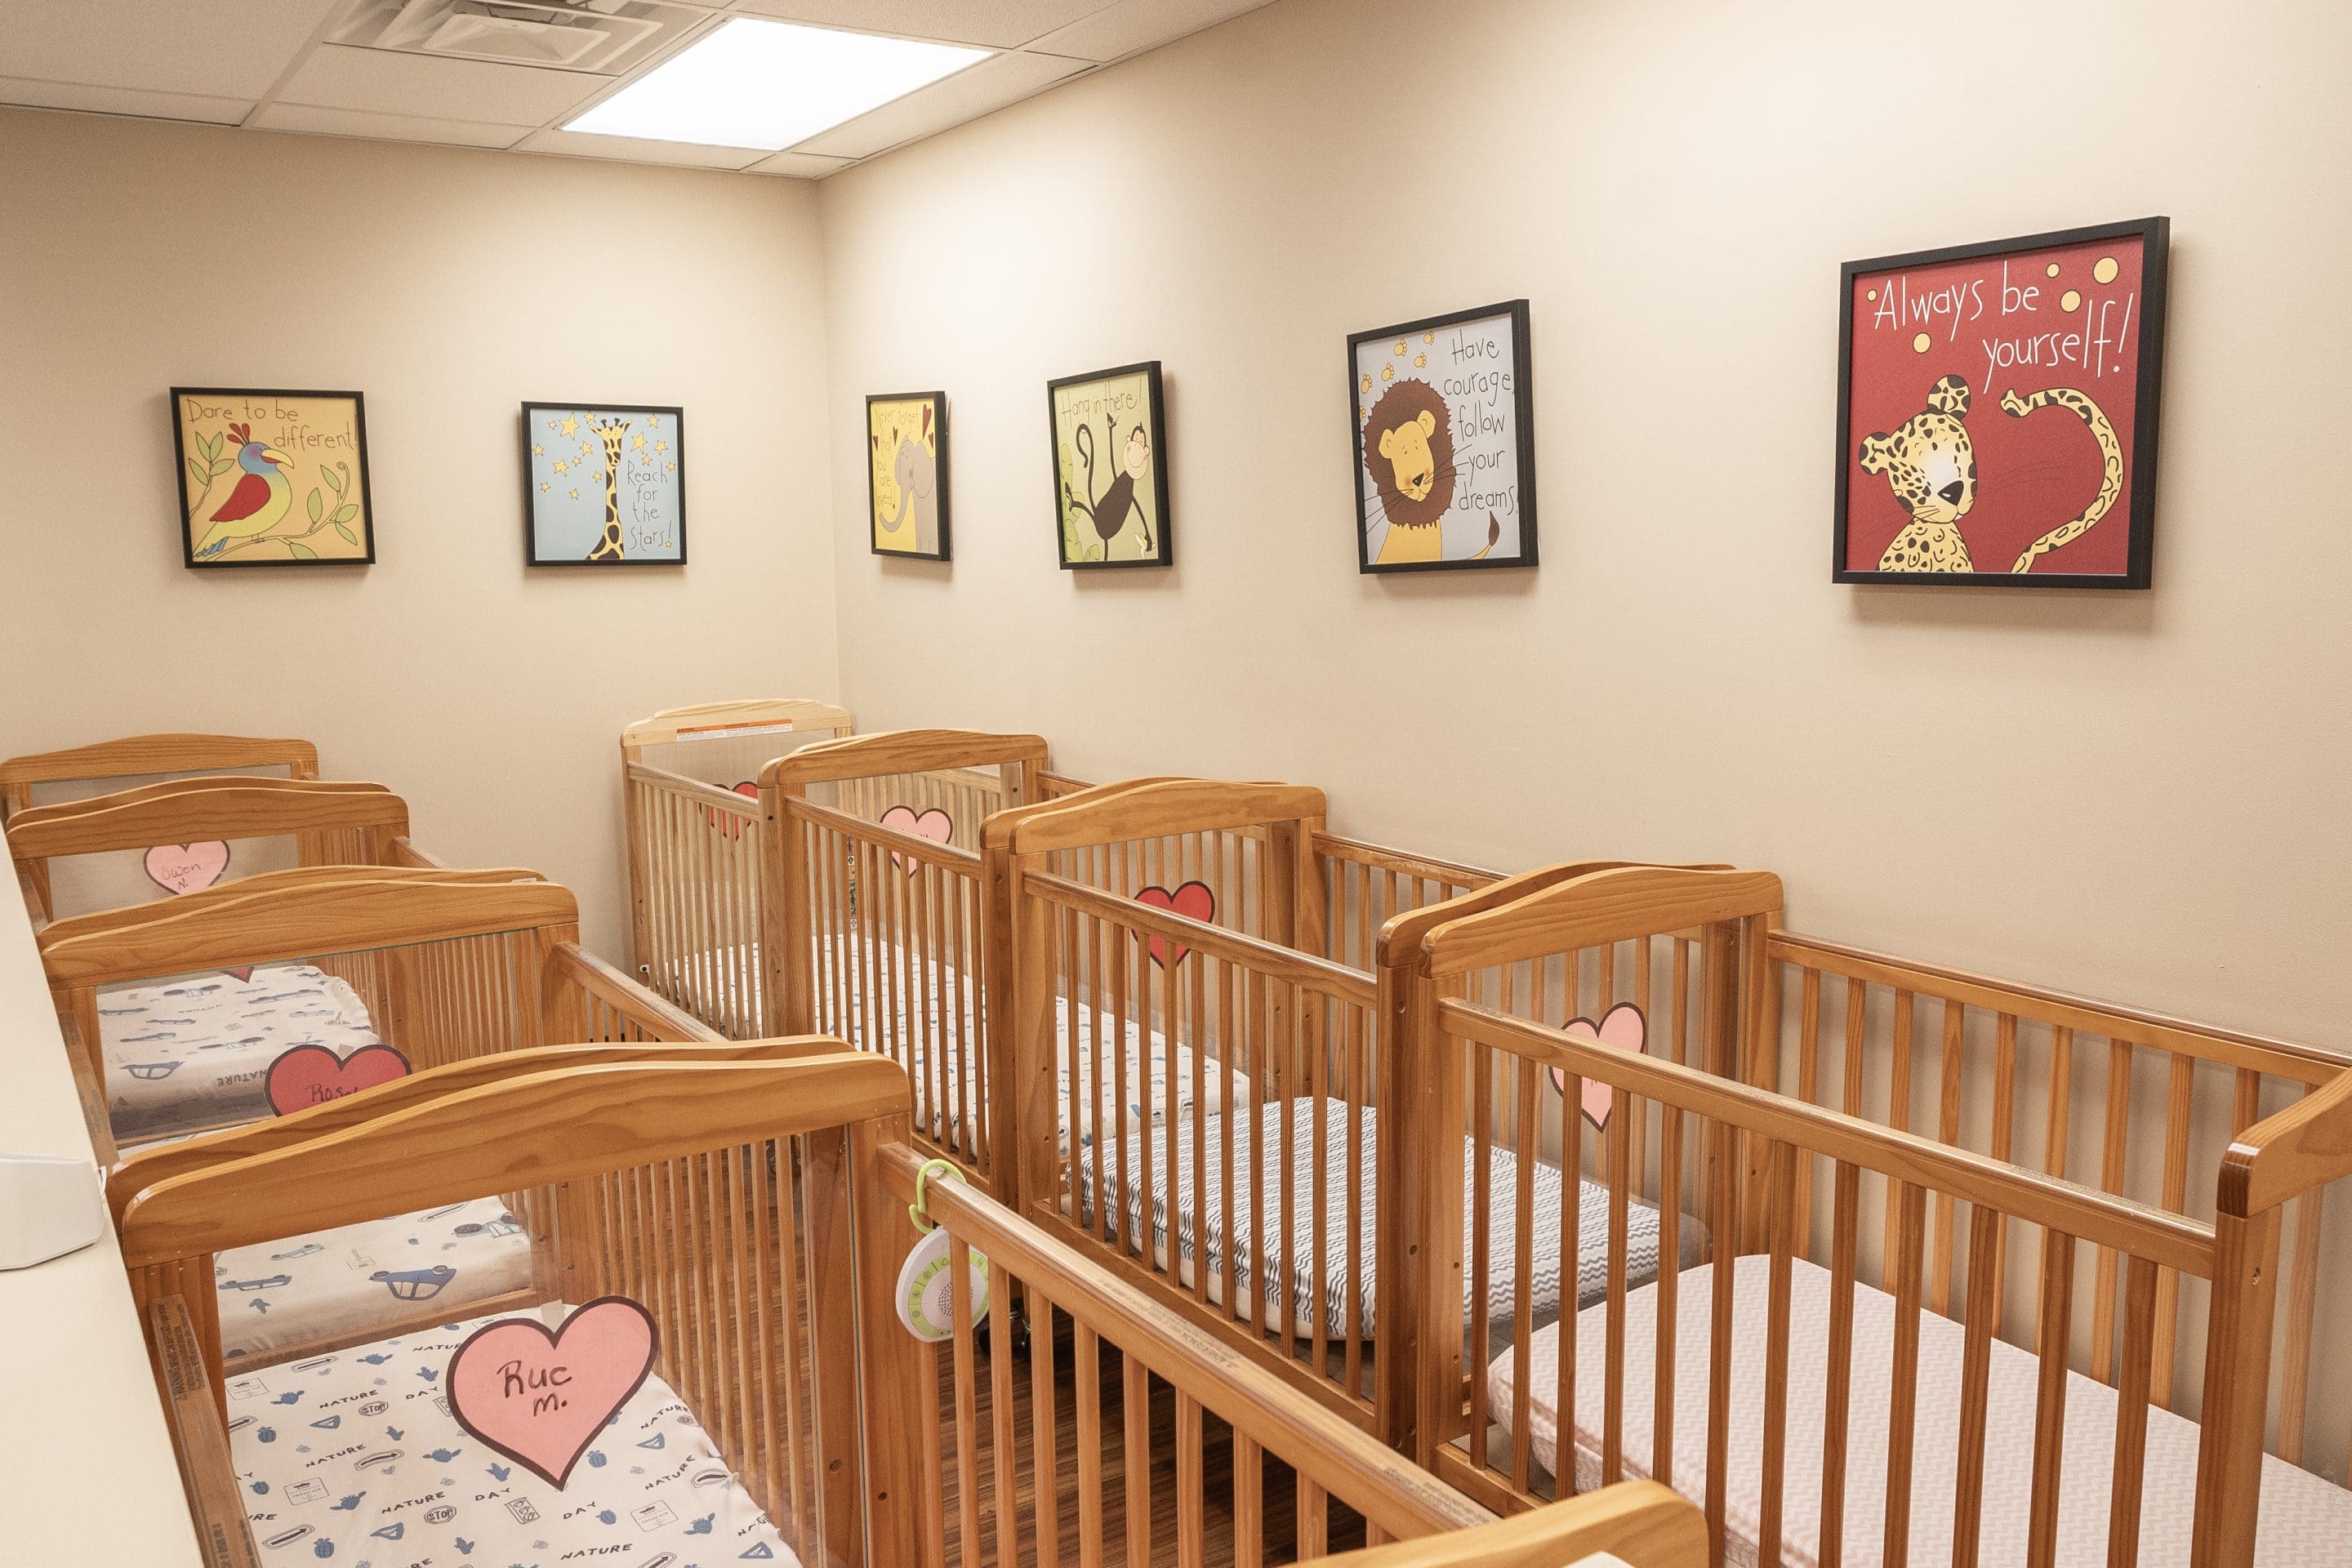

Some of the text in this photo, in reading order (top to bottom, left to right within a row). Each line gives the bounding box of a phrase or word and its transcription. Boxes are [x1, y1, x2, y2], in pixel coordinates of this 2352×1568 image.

[1874, 260, 2040, 341] Always be
[1451, 327, 1499, 366] Have
[1982, 292, 2134, 394] yourself!
[187, 396, 298, 423] Dare to be
[1058, 377, 1143, 430] Hang in there!
[274, 412, 357, 452] different!
[1458, 400, 1505, 442] follow
[627, 460, 668, 487] Reach
[1468, 450, 1505, 487] your
[636, 483, 658, 503] for
[1459, 481, 1517, 516] dreams
[632, 501, 660, 523] the
[630, 520, 673, 552] Stars!
[162, 863, 202, 880] Owen
[178, 877, 189, 890] N.
[412, 1343, 463, 1352] NATUR
[319, 1389, 379, 1409] NATURE
[406, 1387, 439, 1400] DAY
[305, 1444, 367, 1468] NATURE
[644, 1454, 696, 1490] NATURE
[381, 1491, 446, 1514] NATURE
[474, 1486, 512, 1502] DAY
[428, 1508, 452, 1521] STOP
[563, 1501, 596, 1520] DAY
[560, 1543, 633, 1561] NATURE
